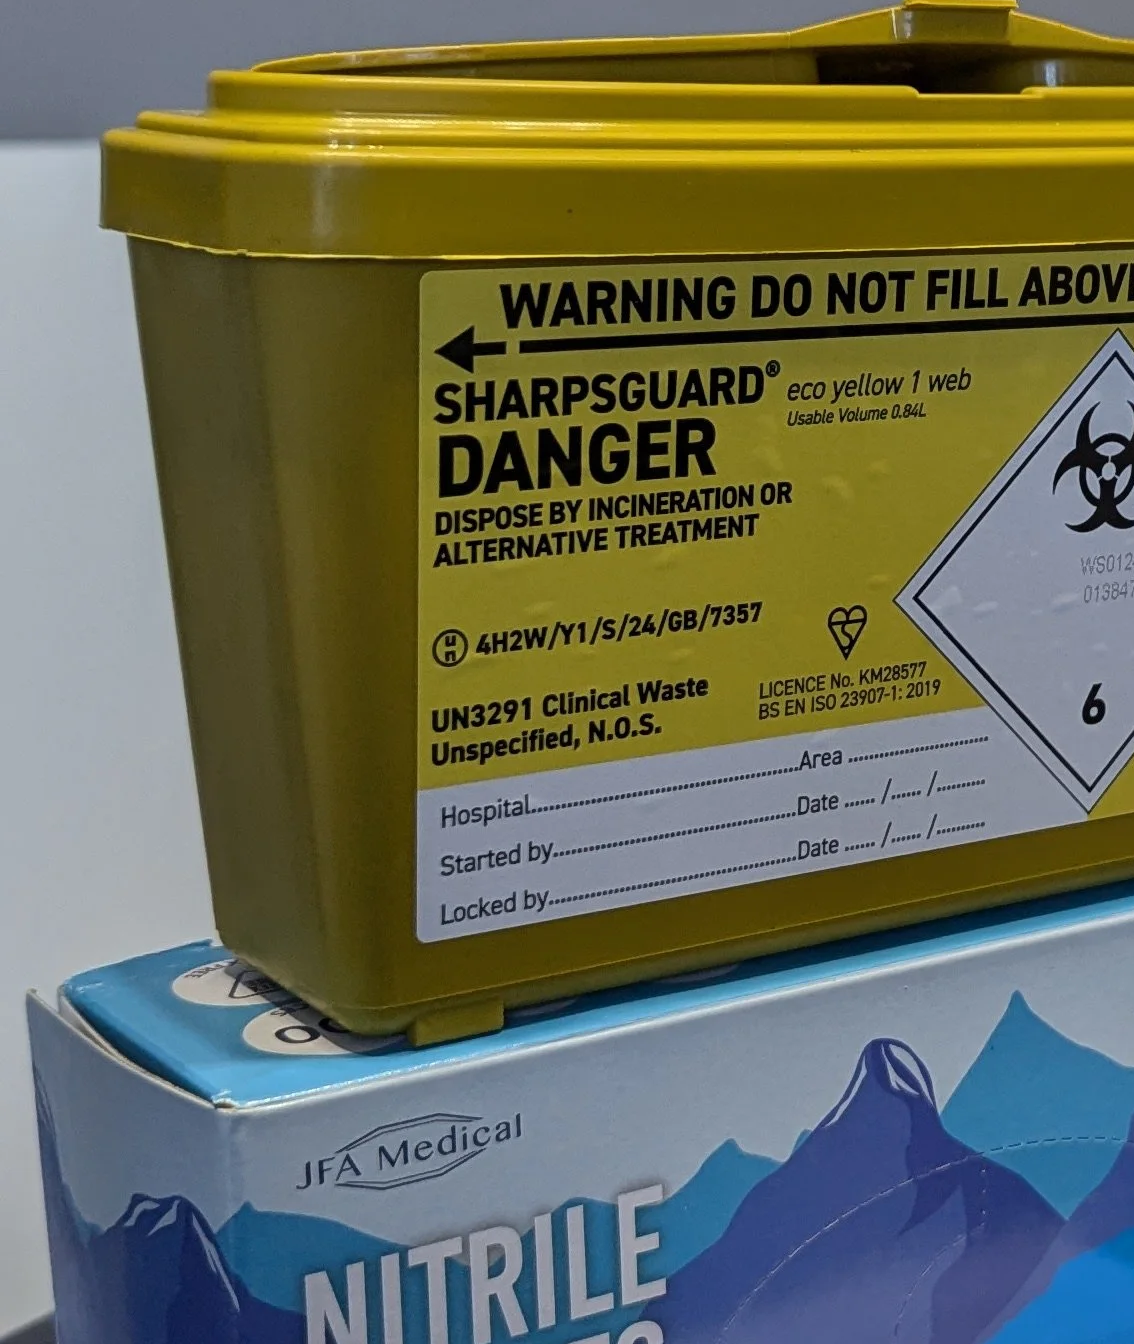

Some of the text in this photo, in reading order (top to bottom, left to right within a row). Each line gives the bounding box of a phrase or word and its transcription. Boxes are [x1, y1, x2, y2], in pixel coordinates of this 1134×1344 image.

[500, 275, 736, 329] WARNING
[751, 273, 812, 318] DO
[827, 270, 914, 315] NOT
[926, 267, 1008, 311] FILL
[787, 367, 972, 404] eco yellow 1 web
[787, 402, 927, 426] Usable Volume 0.84L
[438, 417, 717, 498] DANGER
[435, 482, 793, 536] DISPOSE BY INCINERATION OR
[433, 513, 759, 568] ALTERNATIVE TREATMENT
[475, 602, 763, 655] 4H2W/Y1/S/24/GB/7357
[431, 676, 709, 733] UN3291 Clinical Waste
[759, 661, 927, 699] LICENCE No. KM28577
[759, 702, 779, 720] BS
[784, 698, 806, 716] EN
[811, 694, 836, 712] ISO
[906, 678, 941, 699] 2019
[1081, 682, 1106, 725] 6
[431, 713, 662, 766] Unspecified, N.O.S.
[799, 749, 843, 771] Area
[440, 843, 521, 877] Started
[797, 794, 839, 816] Date
[441, 892, 517, 925] Locked
[797, 838, 839, 860] Date
[295, 1113, 521, 1191] JFA Medical
